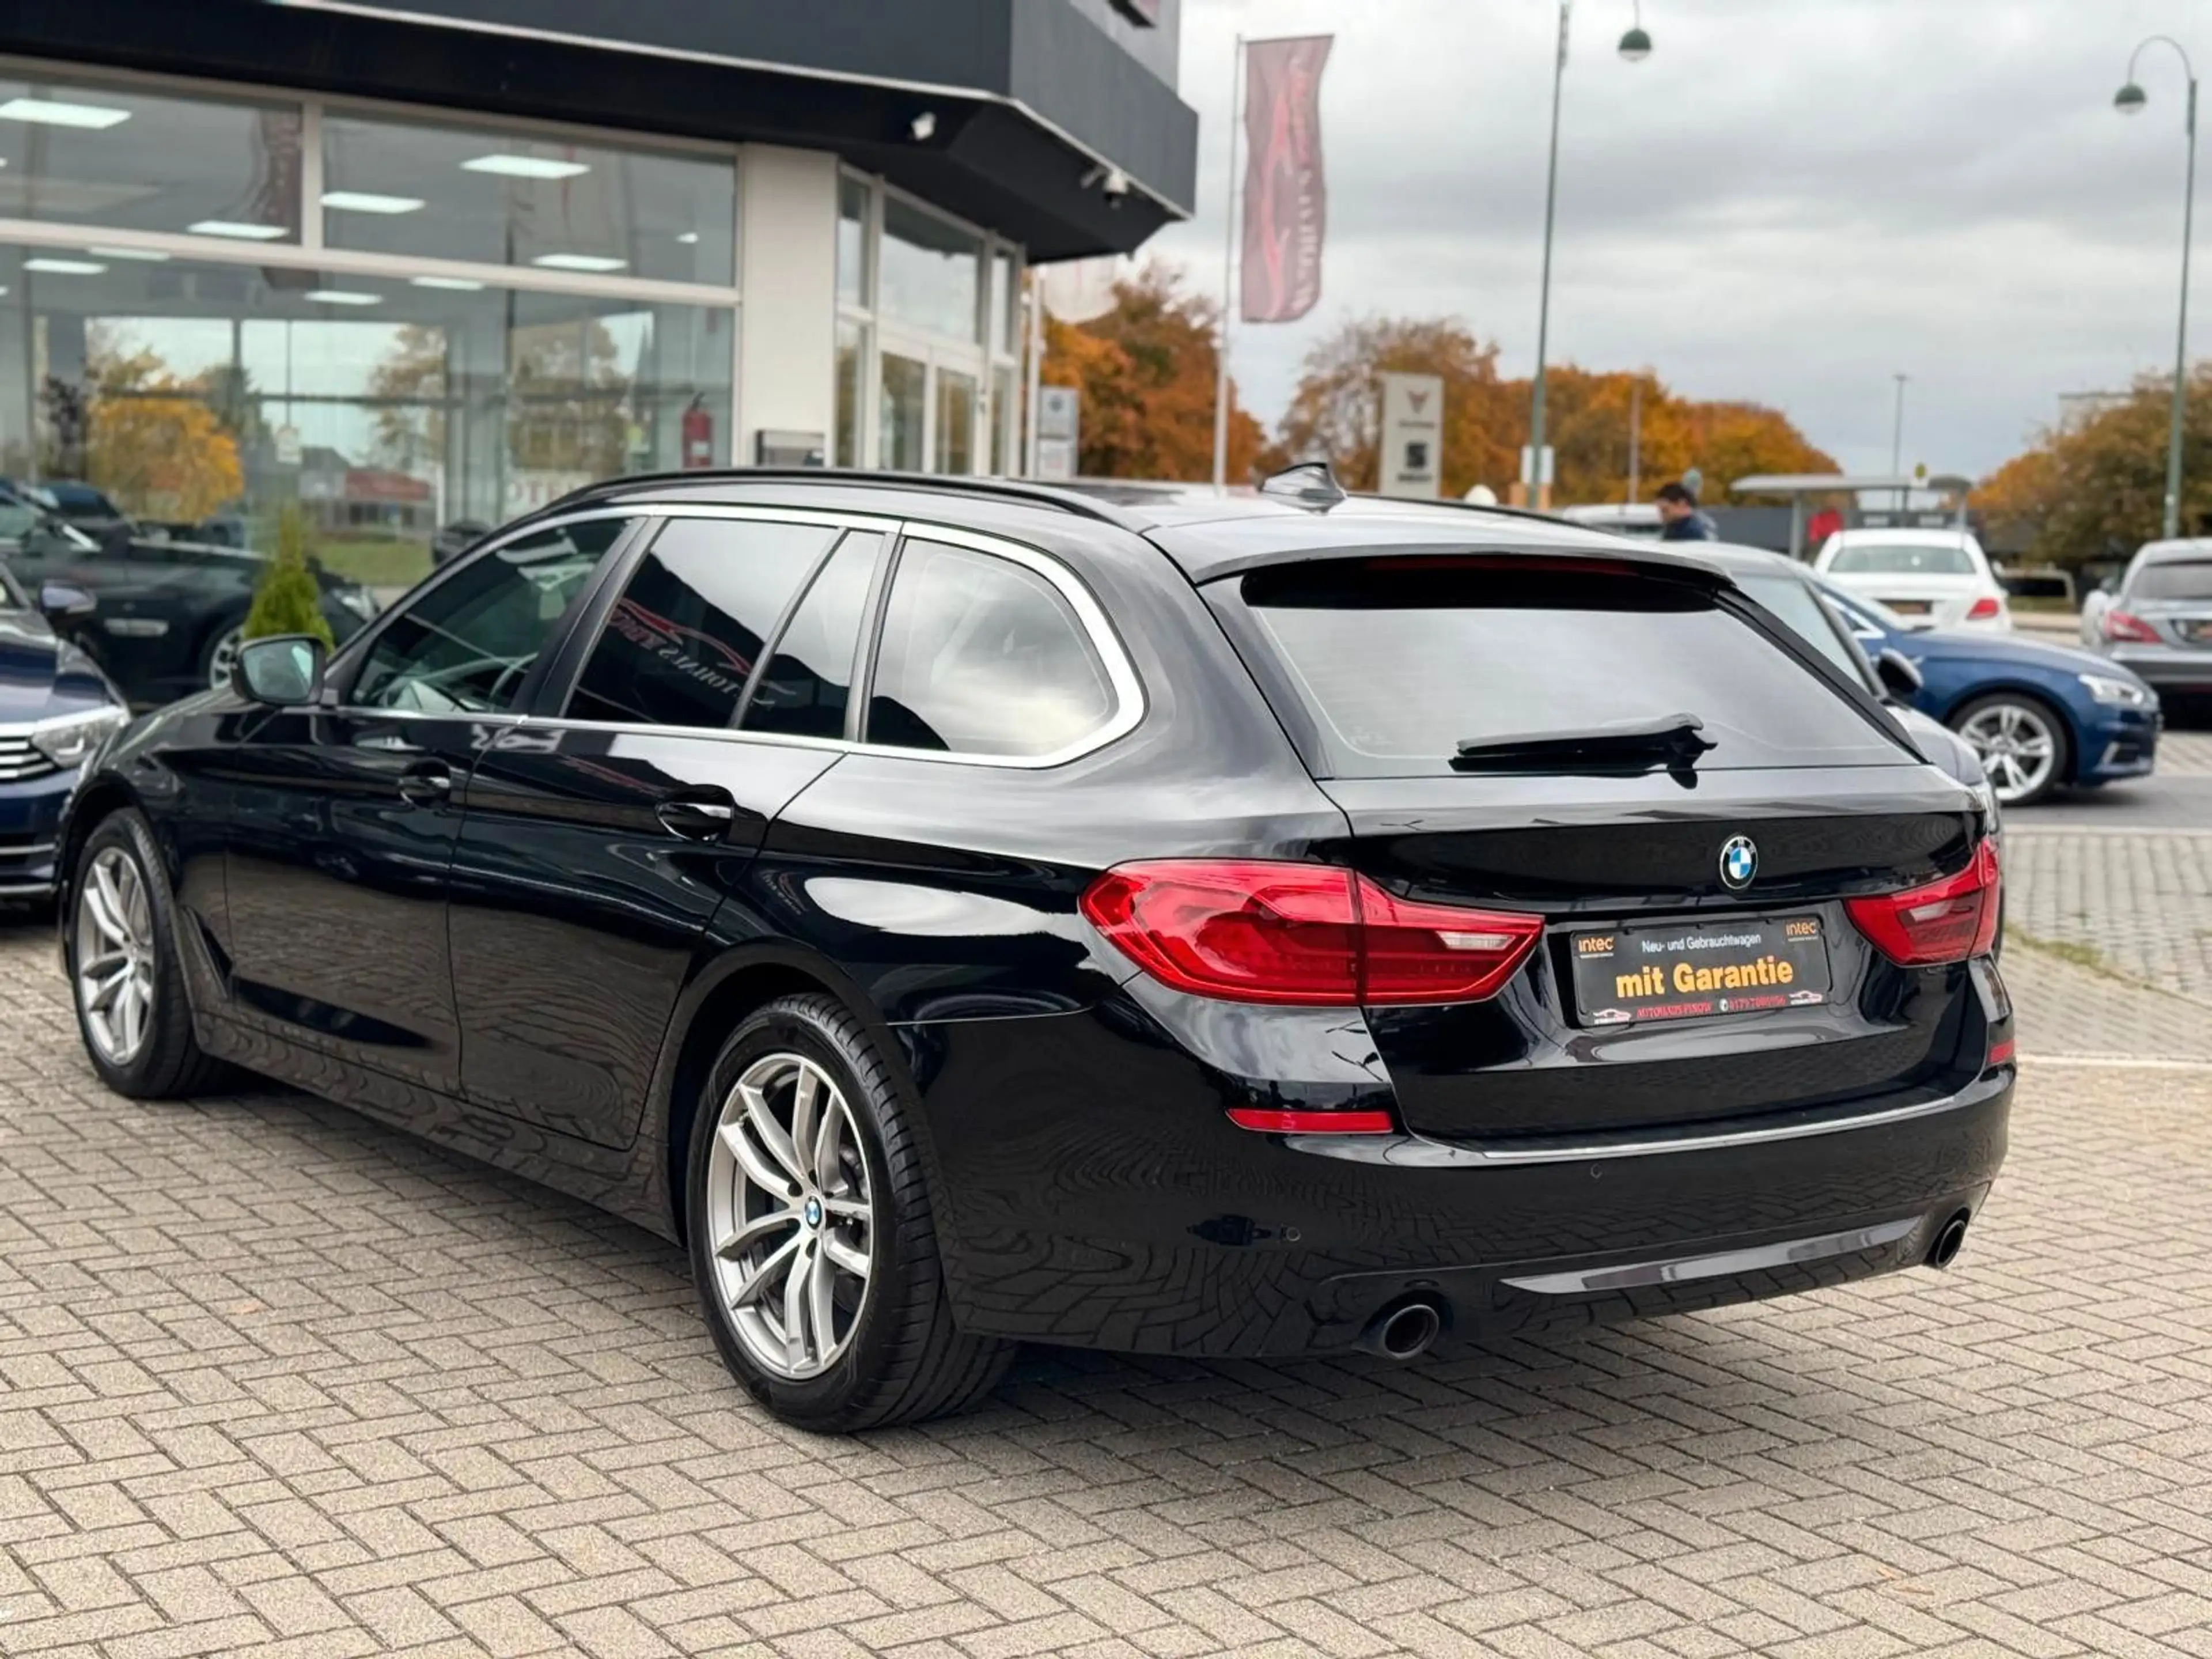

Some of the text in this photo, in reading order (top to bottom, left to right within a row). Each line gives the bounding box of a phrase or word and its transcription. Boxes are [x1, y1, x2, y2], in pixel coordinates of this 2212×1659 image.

[1642, 934, 1762, 953] Neu- und Gebrauchtwagen
[1616, 955, 1794, 998] mit Garantie
